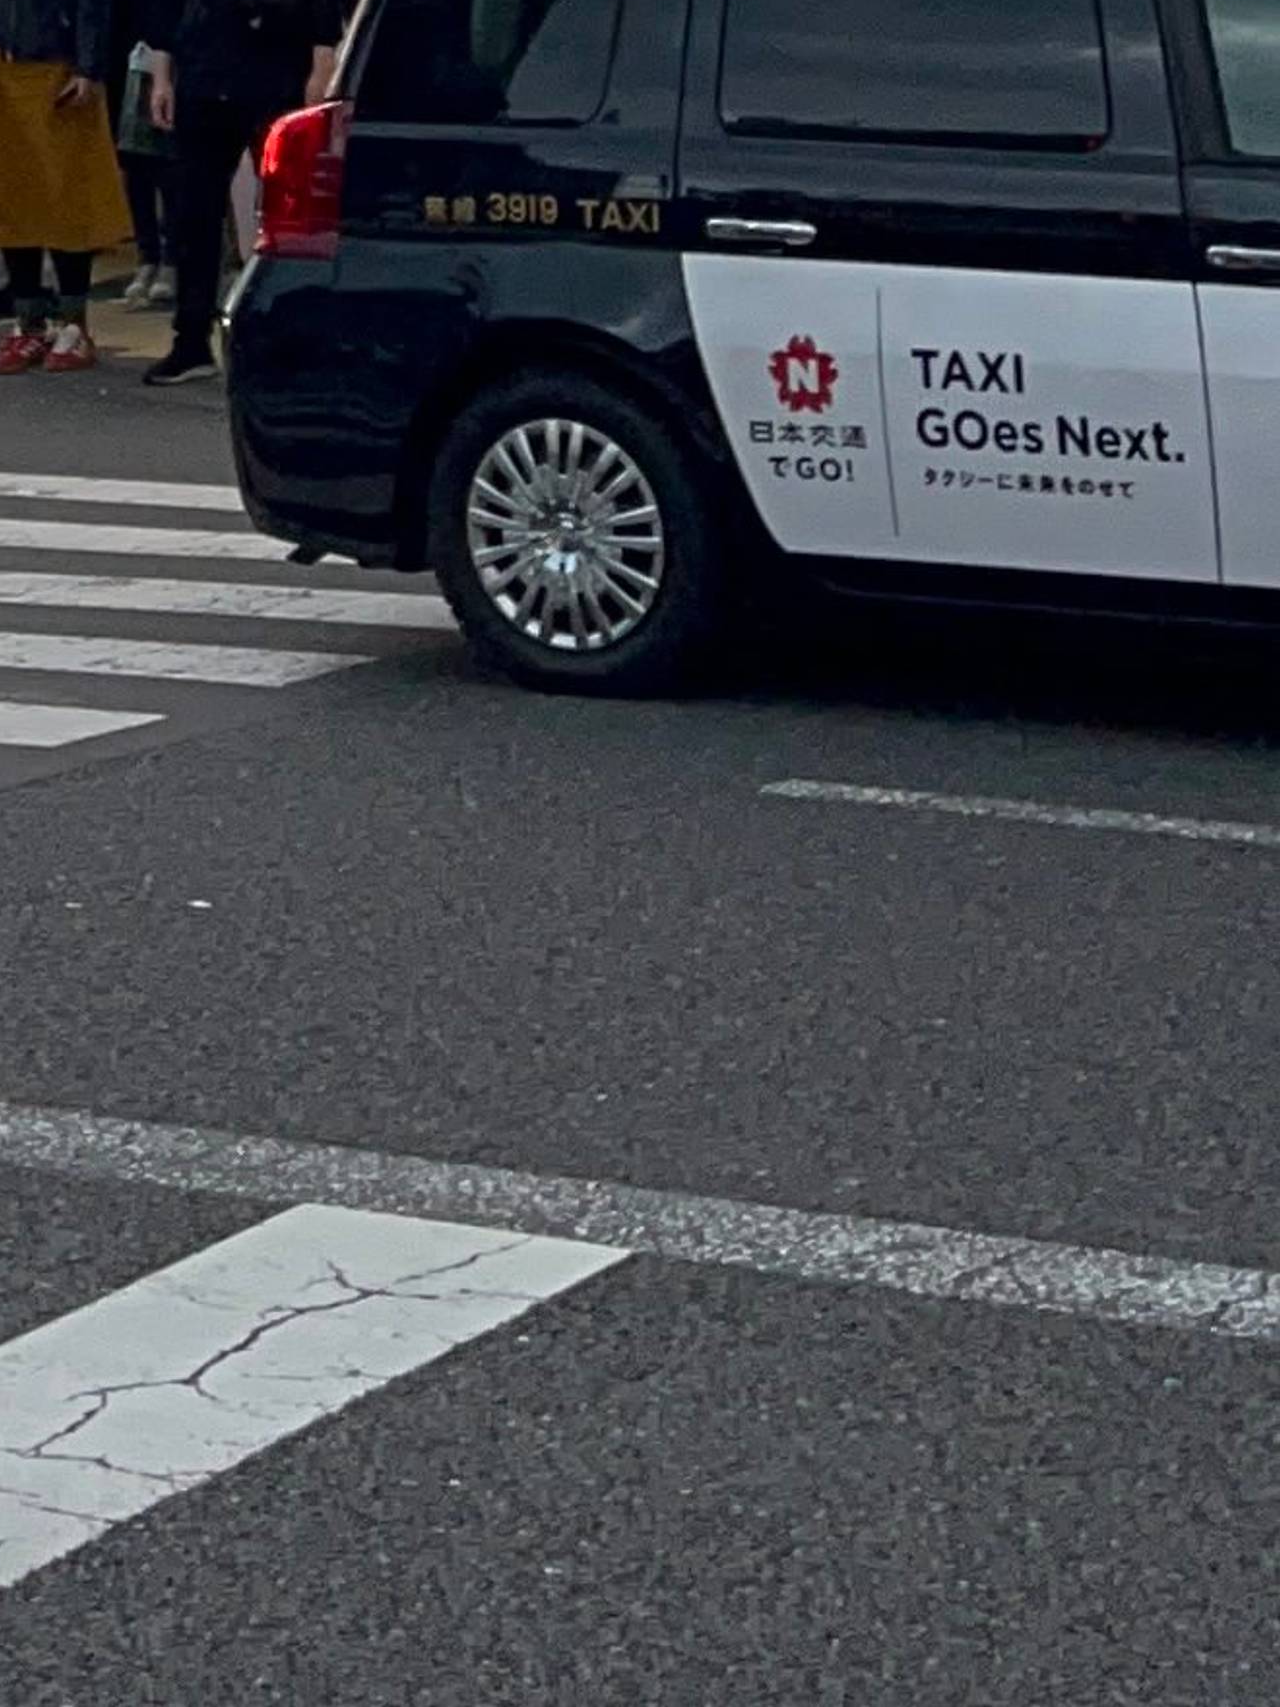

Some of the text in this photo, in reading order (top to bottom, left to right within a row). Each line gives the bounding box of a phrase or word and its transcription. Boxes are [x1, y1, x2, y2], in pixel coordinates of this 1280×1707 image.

[489, 193, 559, 224] 3919
[576, 200, 660, 233] TAXI
[911, 349, 1026, 395] TAXI
[749, 420, 868, 451] 日本交通
[916, 409, 1186, 463] GOes Next.
[769, 455, 855, 483] でGO!
